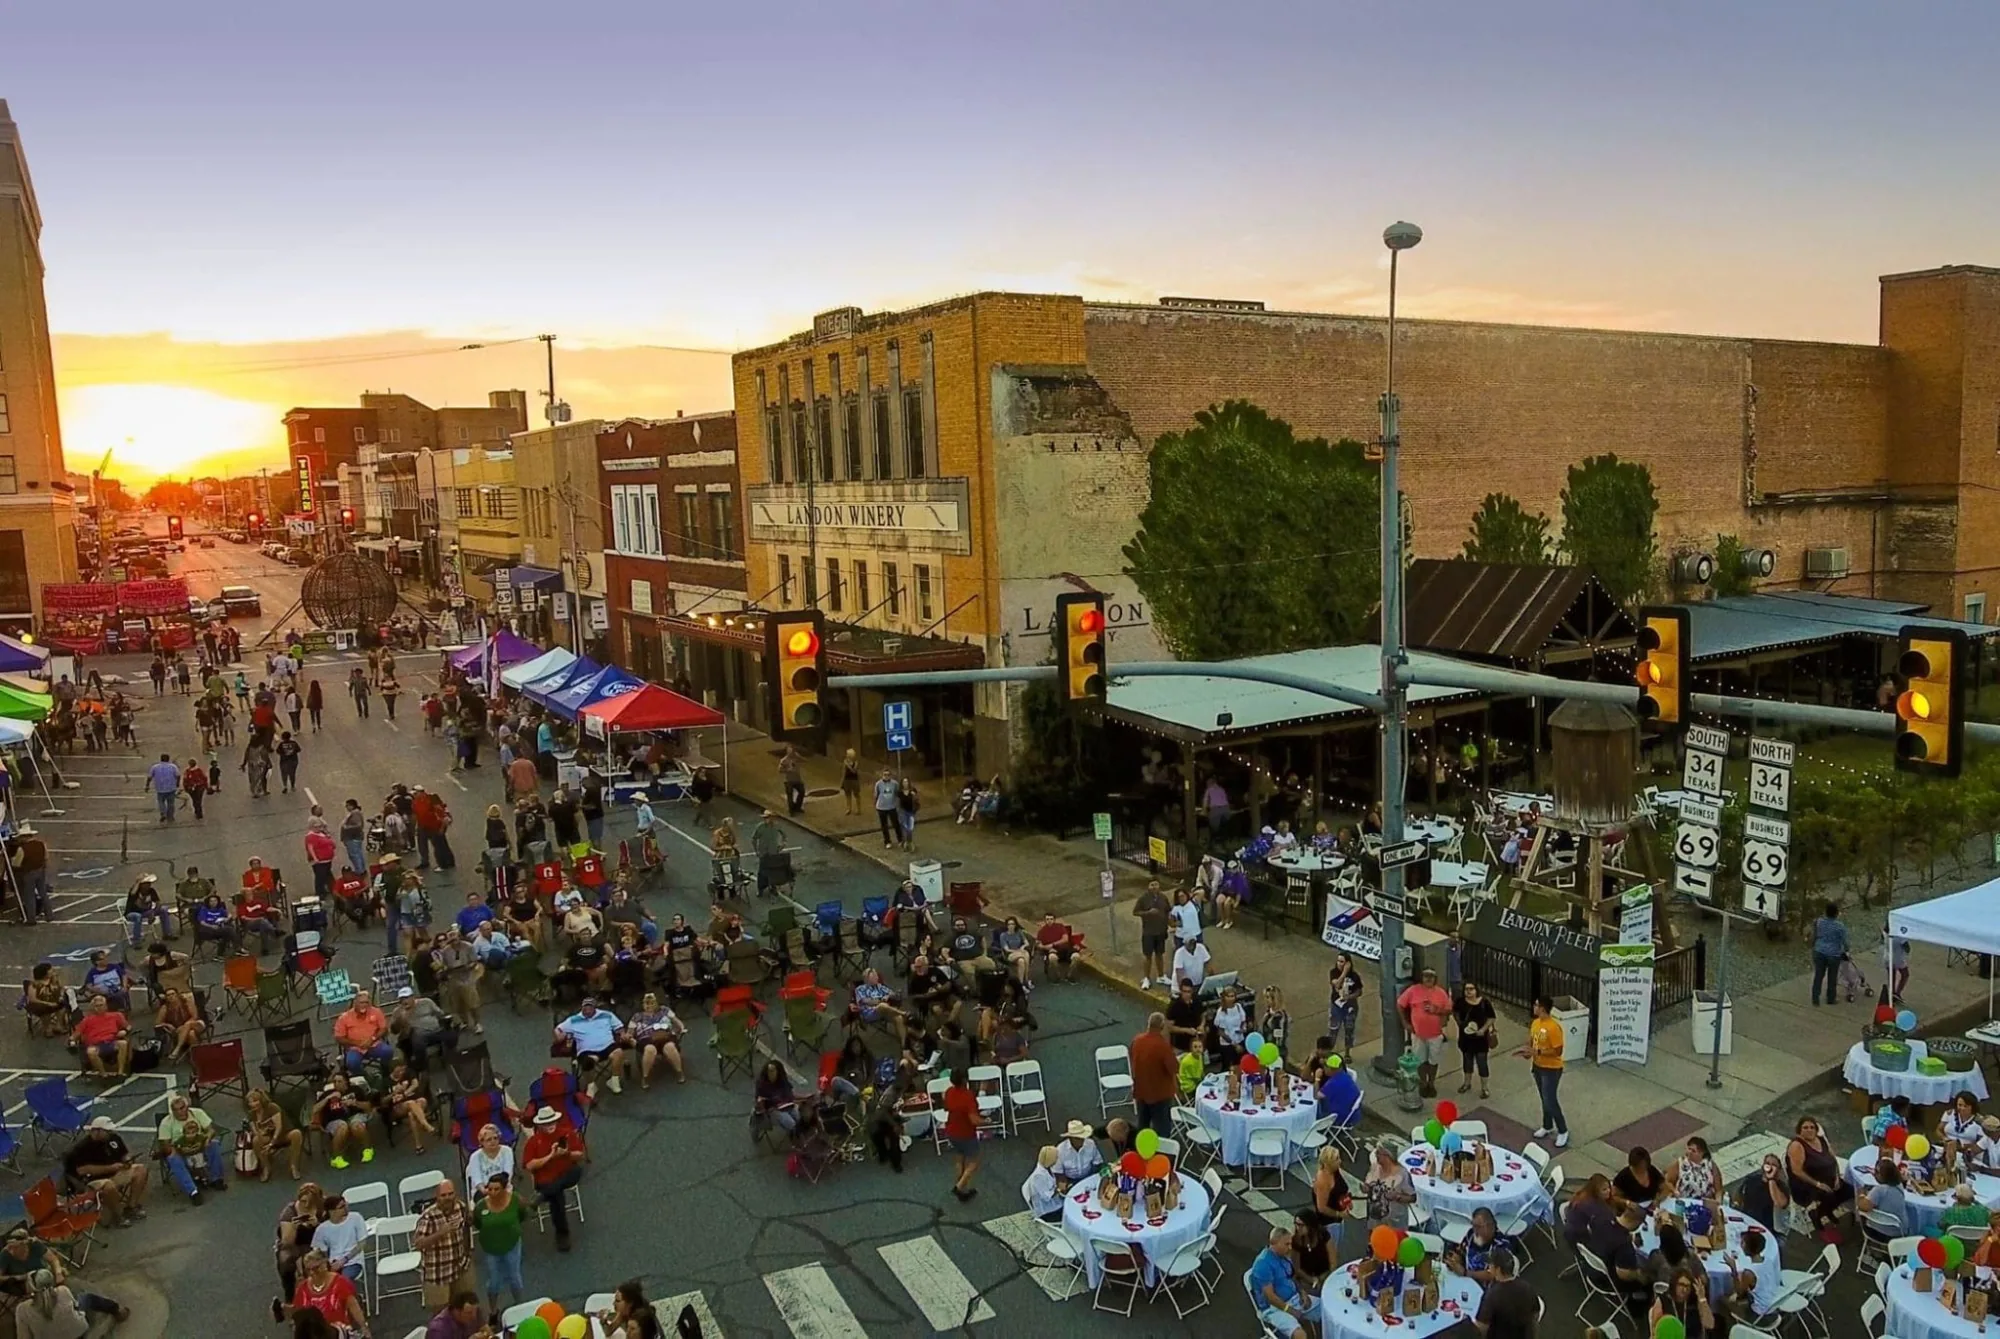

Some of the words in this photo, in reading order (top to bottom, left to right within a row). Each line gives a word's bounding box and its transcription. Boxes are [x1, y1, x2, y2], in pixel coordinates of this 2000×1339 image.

[298, 459, 312, 511] TEXAN
[787, 504, 843, 526] LANDON
[849, 505, 907, 527] WINERY
[498, 592, 512, 601] 69
[887, 703, 908, 729] H
[1688, 728, 1726, 749] SOUTH
[1752, 742, 1791, 761] NORTH
[1690, 754, 1716, 777] 34
[1687, 776, 1716, 791] TEXAS
[1756, 769, 1782, 791] 34
[1753, 790, 1784, 806] TEXAS
[1684, 805, 1715, 820] BUSINESS
[1750, 821, 1784, 837] BUSINESS
[1384, 851, 1399, 861] ONE
[1400, 847, 1415, 858] WAY
[1680, 833, 1714, 858] 69
[1747, 850, 1782, 877] 69
[1374, 897, 1386, 906] ONE
[1387, 902, 1400, 913] WAY
[1526, 940, 1556, 959] NOW
[1601, 977, 1620, 986] Special
[1621, 976, 1642, 984] Thanks
